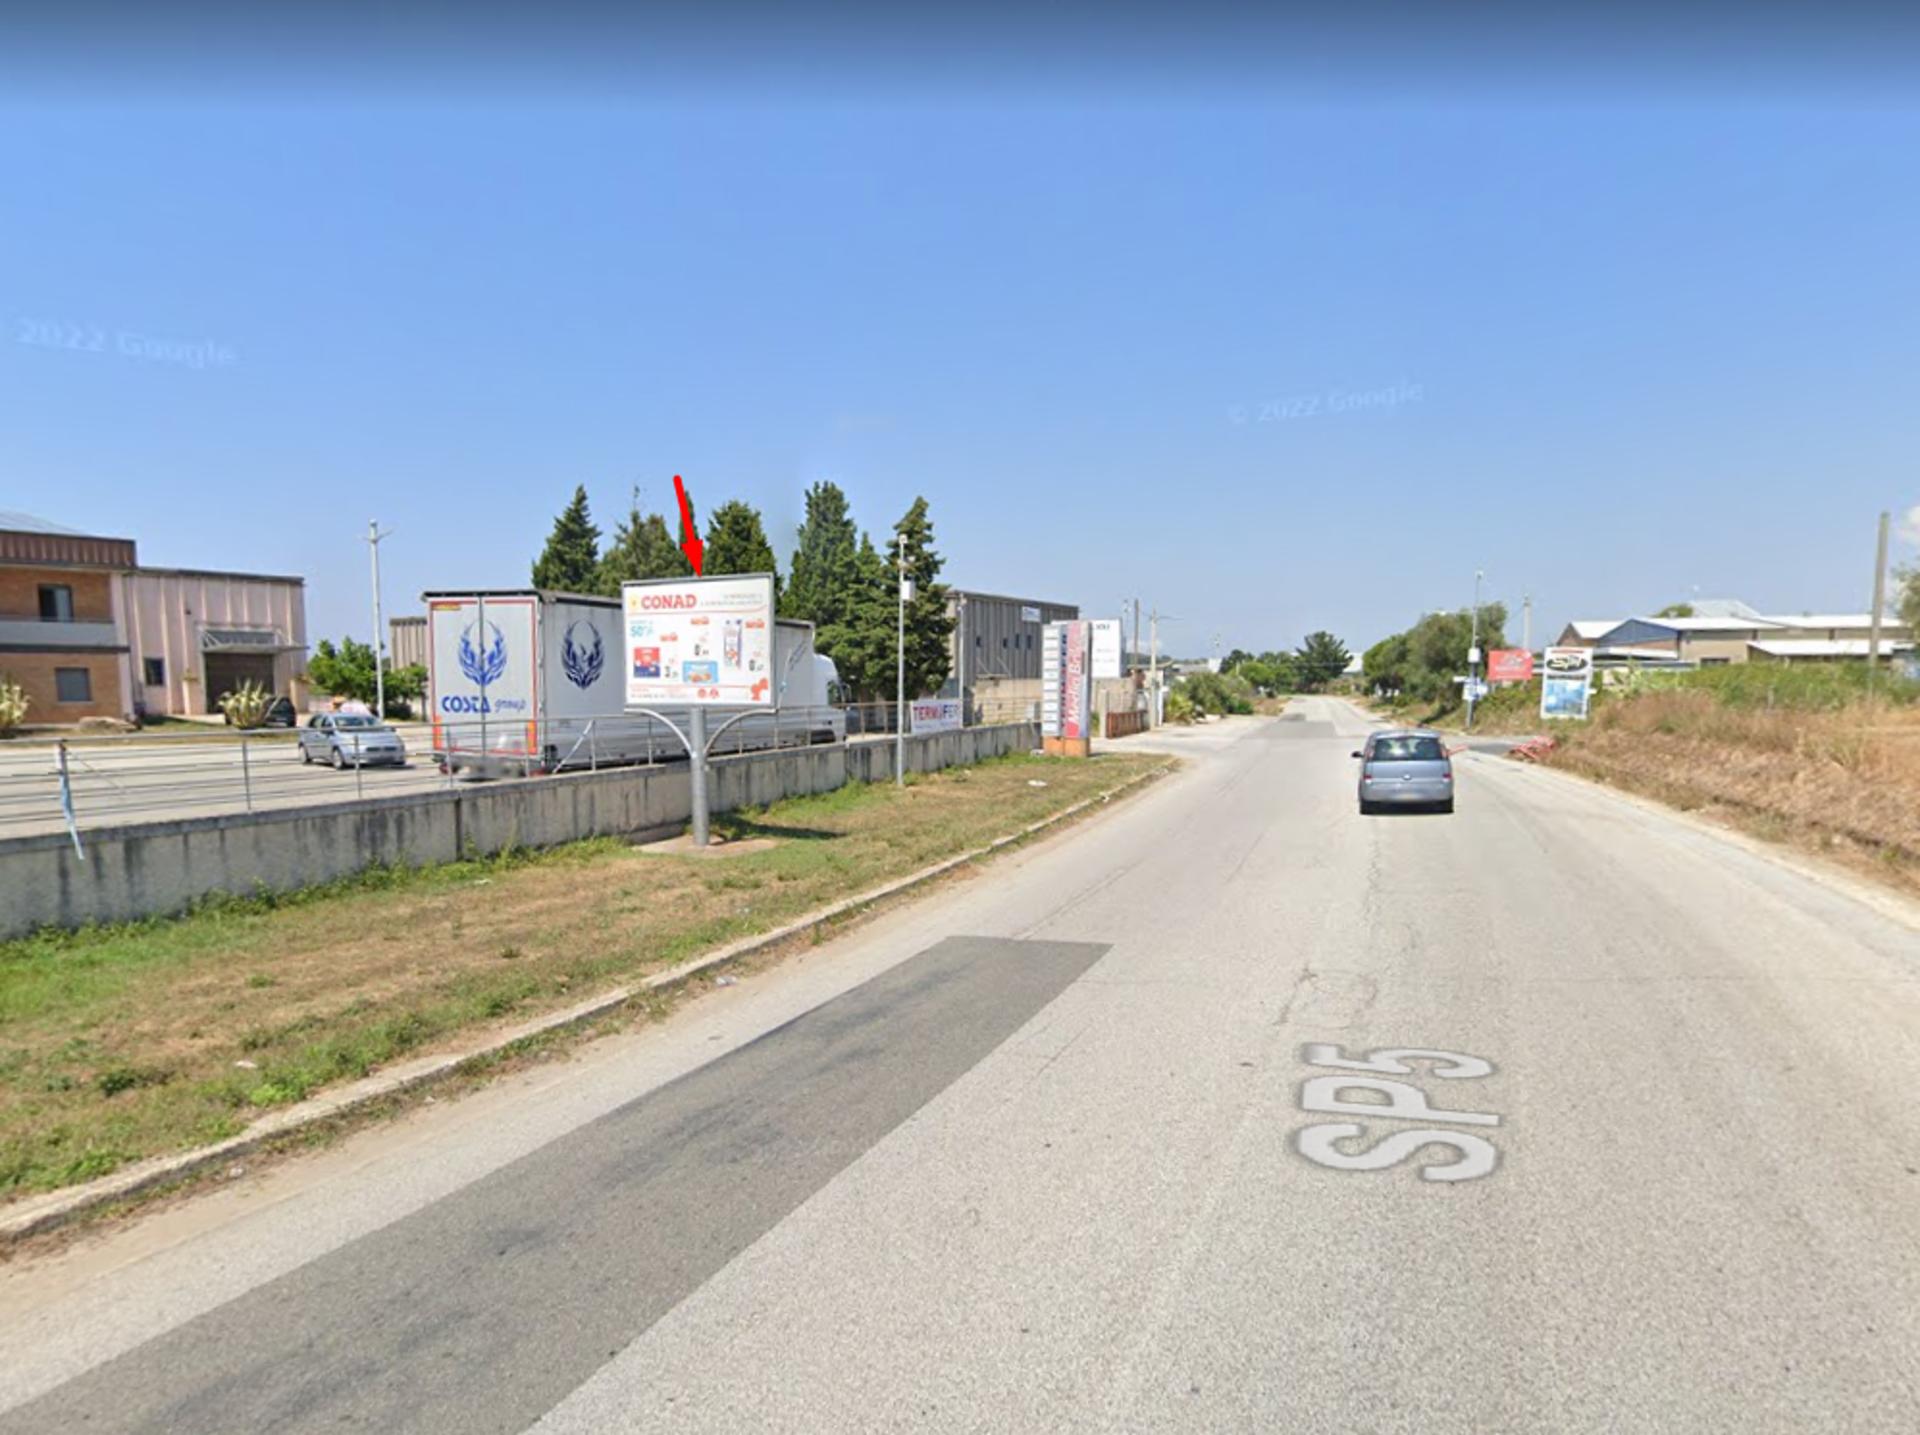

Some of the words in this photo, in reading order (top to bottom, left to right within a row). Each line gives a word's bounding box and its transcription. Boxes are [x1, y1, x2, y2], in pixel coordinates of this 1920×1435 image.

[641, 594, 697, 609] CONAD
[441, 696, 491, 713] COSTA
[494, 699, 526, 714] group
